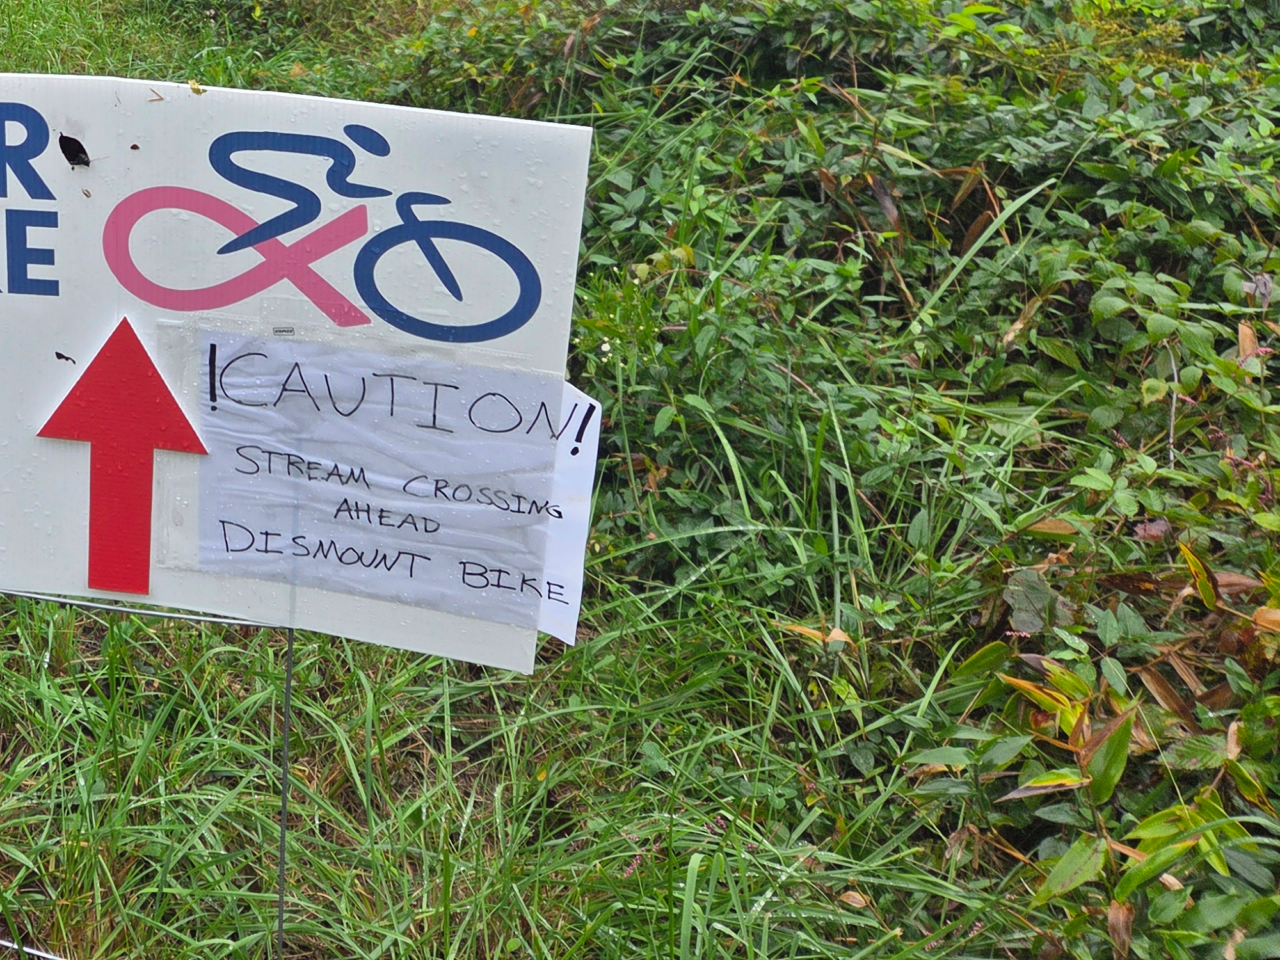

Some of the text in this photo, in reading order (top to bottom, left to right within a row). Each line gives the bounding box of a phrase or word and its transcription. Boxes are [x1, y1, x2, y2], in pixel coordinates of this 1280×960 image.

[235, 445, 563, 520] STREAM CROSSING
[333, 498, 441, 534] AHEAD
[218, 519, 570, 606] DISMOUNT BIKE
